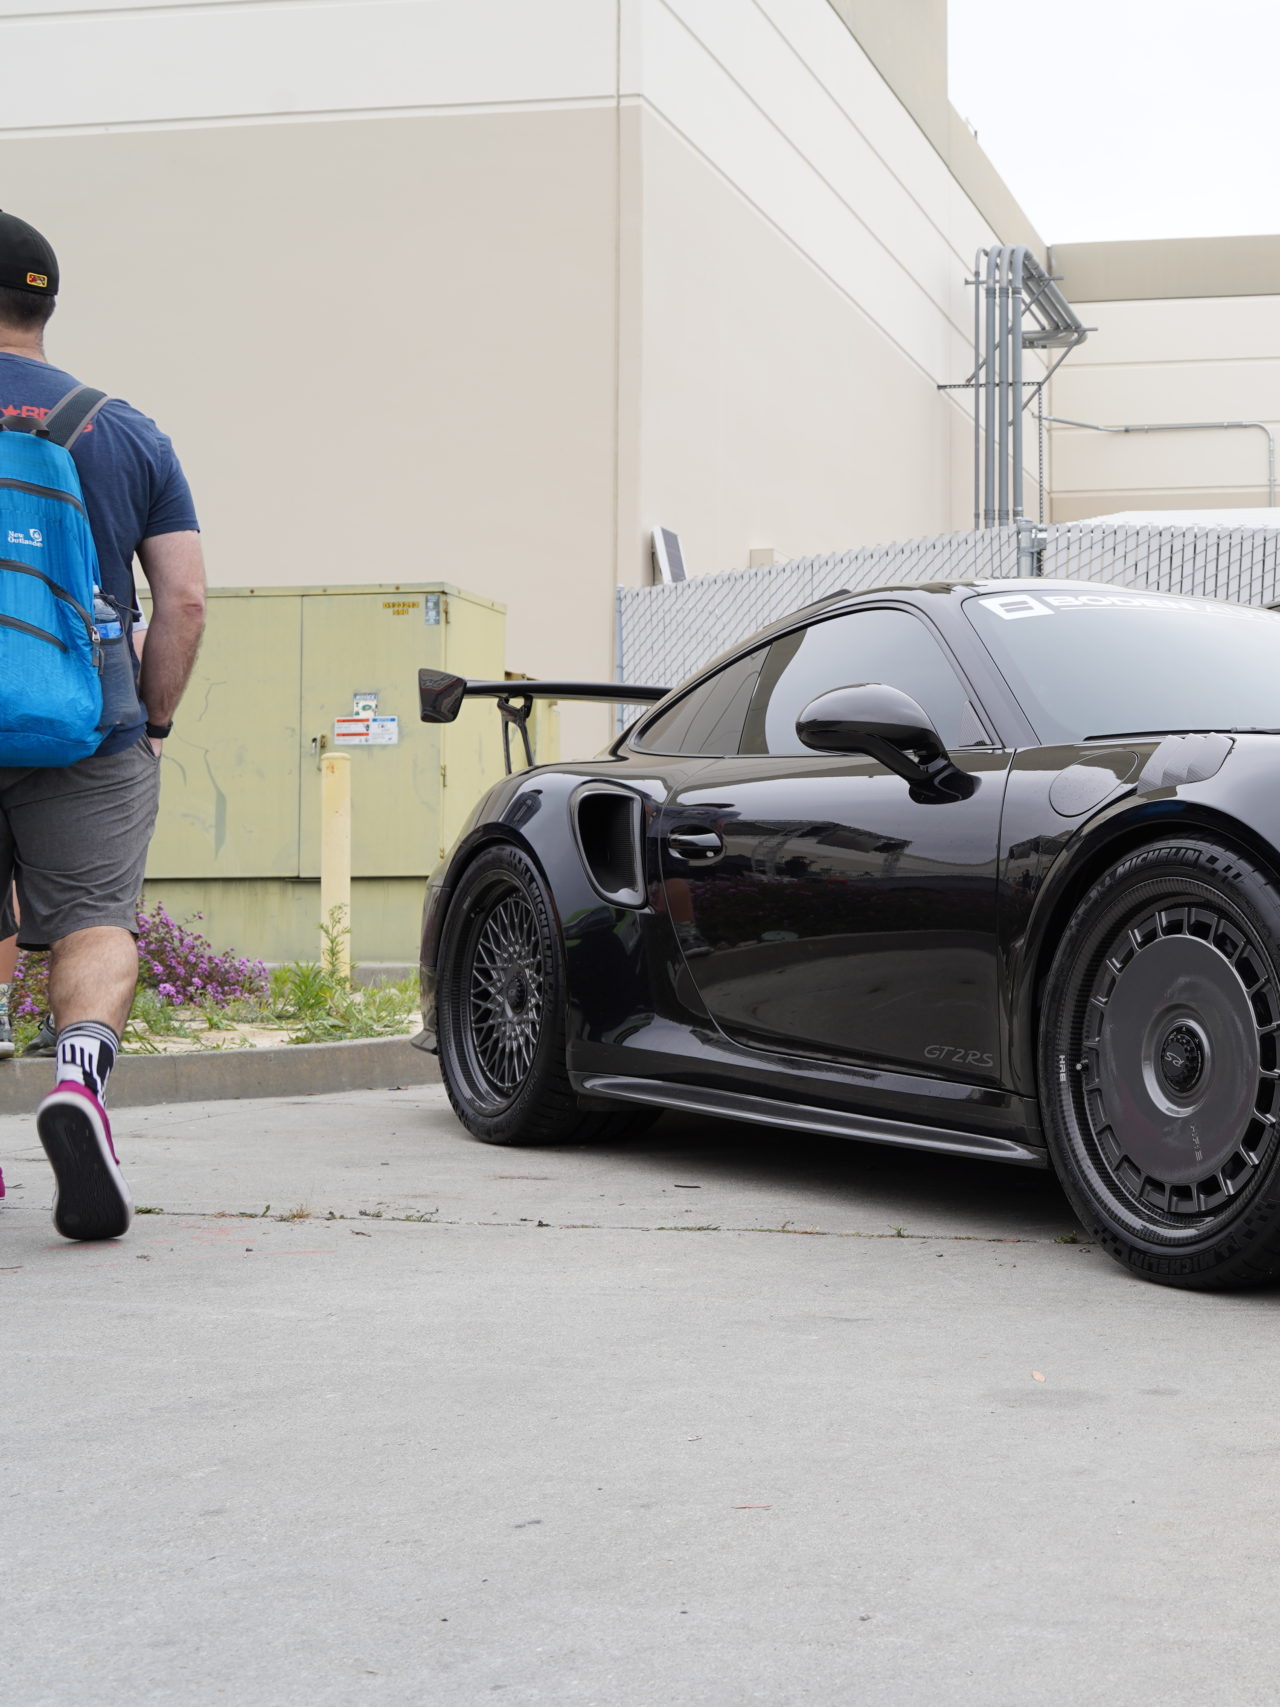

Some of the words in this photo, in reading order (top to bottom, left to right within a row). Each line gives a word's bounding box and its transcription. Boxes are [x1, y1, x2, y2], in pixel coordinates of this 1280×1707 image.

[1115, 848, 1200, 880] MICHELIN
[529, 881, 553, 975] MICHELIN
[1129, 1248, 1217, 1275] MICHELIN
